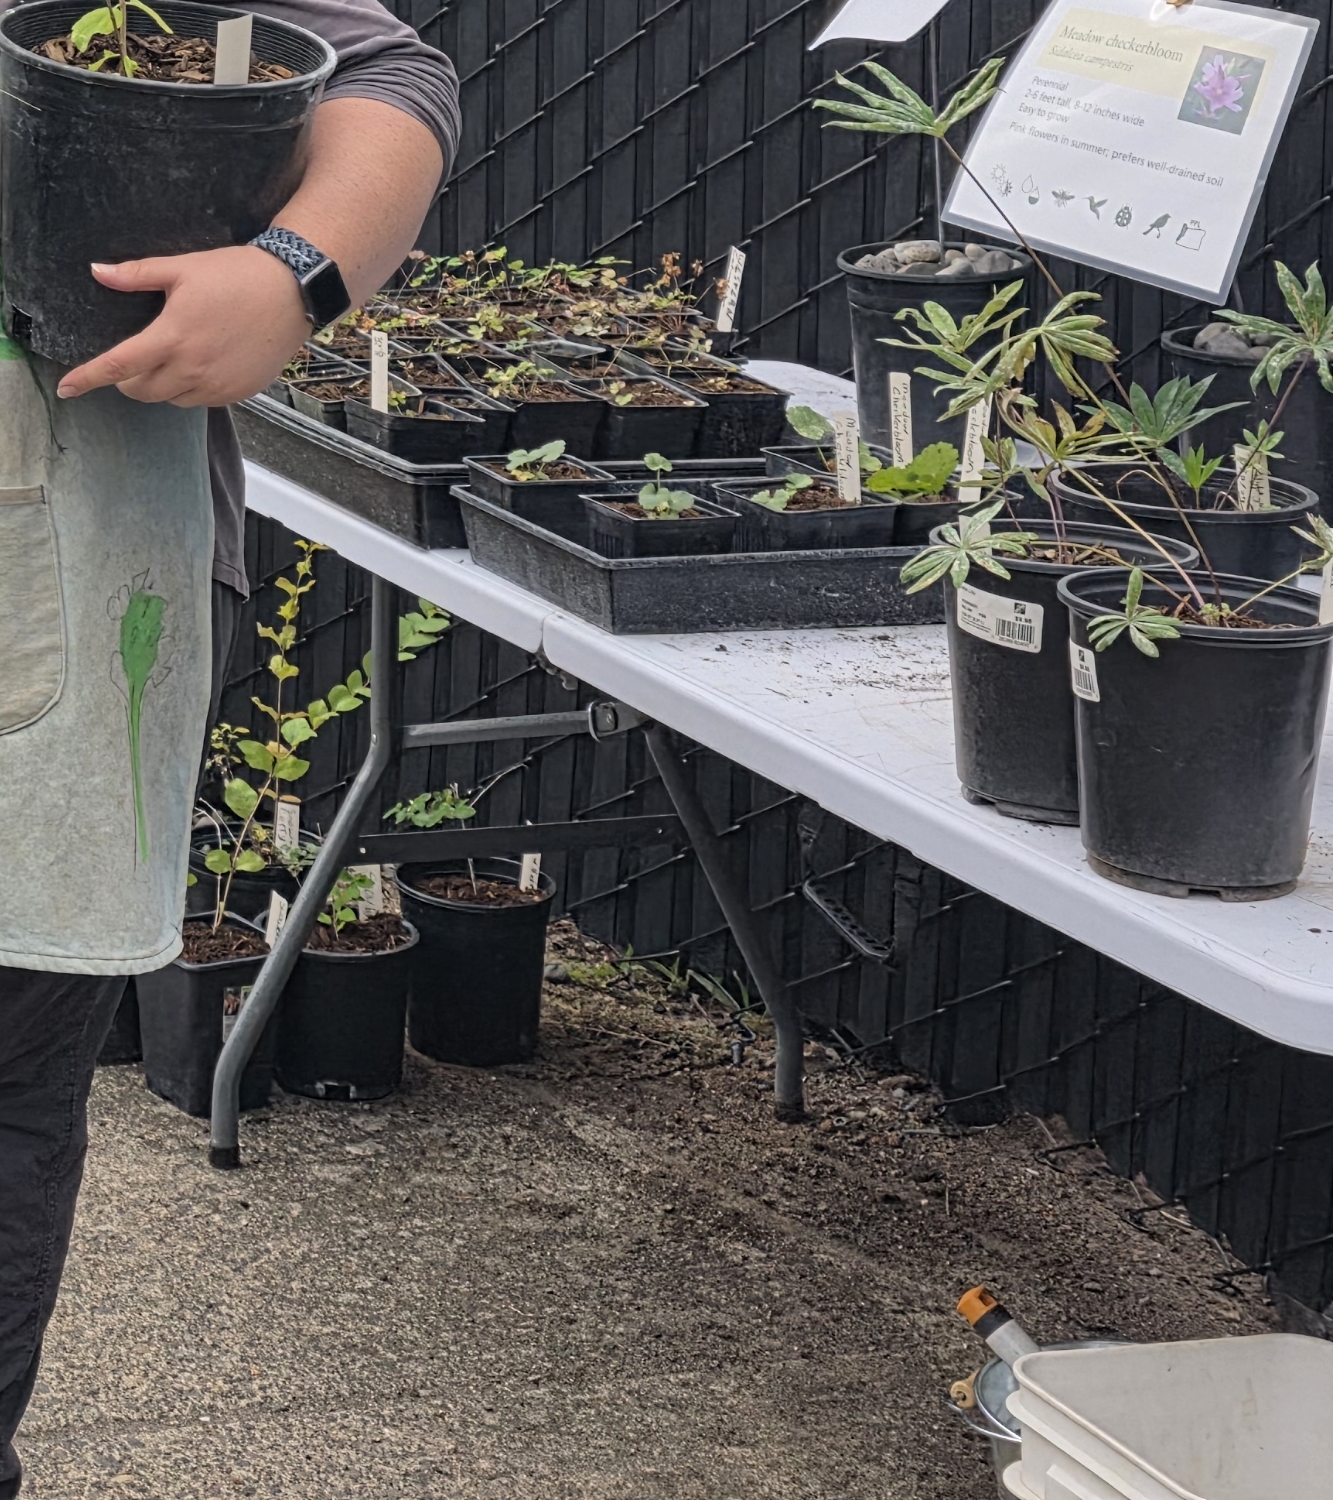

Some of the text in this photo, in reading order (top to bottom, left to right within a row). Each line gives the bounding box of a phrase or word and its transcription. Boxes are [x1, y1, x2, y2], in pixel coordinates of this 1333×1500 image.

[1059, 25, 1184, 62] Meadow checkerbloom
[1031, 75, 1069, 92] Perennial
[1018, 102, 1070, 124] Easy to grow
[1039, 93, 1055, 105] feet
[1073, 99, 1093, 113] 8-12
[1093, 102, 1121, 120] inches
[1122, 111, 1145, 127] wide
[1009, 121, 1028, 135] Pink
[1028, 125, 1059, 143] flowers
[1060, 133, 1070, 145] in
[1111, 148, 1146, 167] prefers
[1147, 159, 1207, 182] well-drained
[1206, 172, 1225, 187] soil
